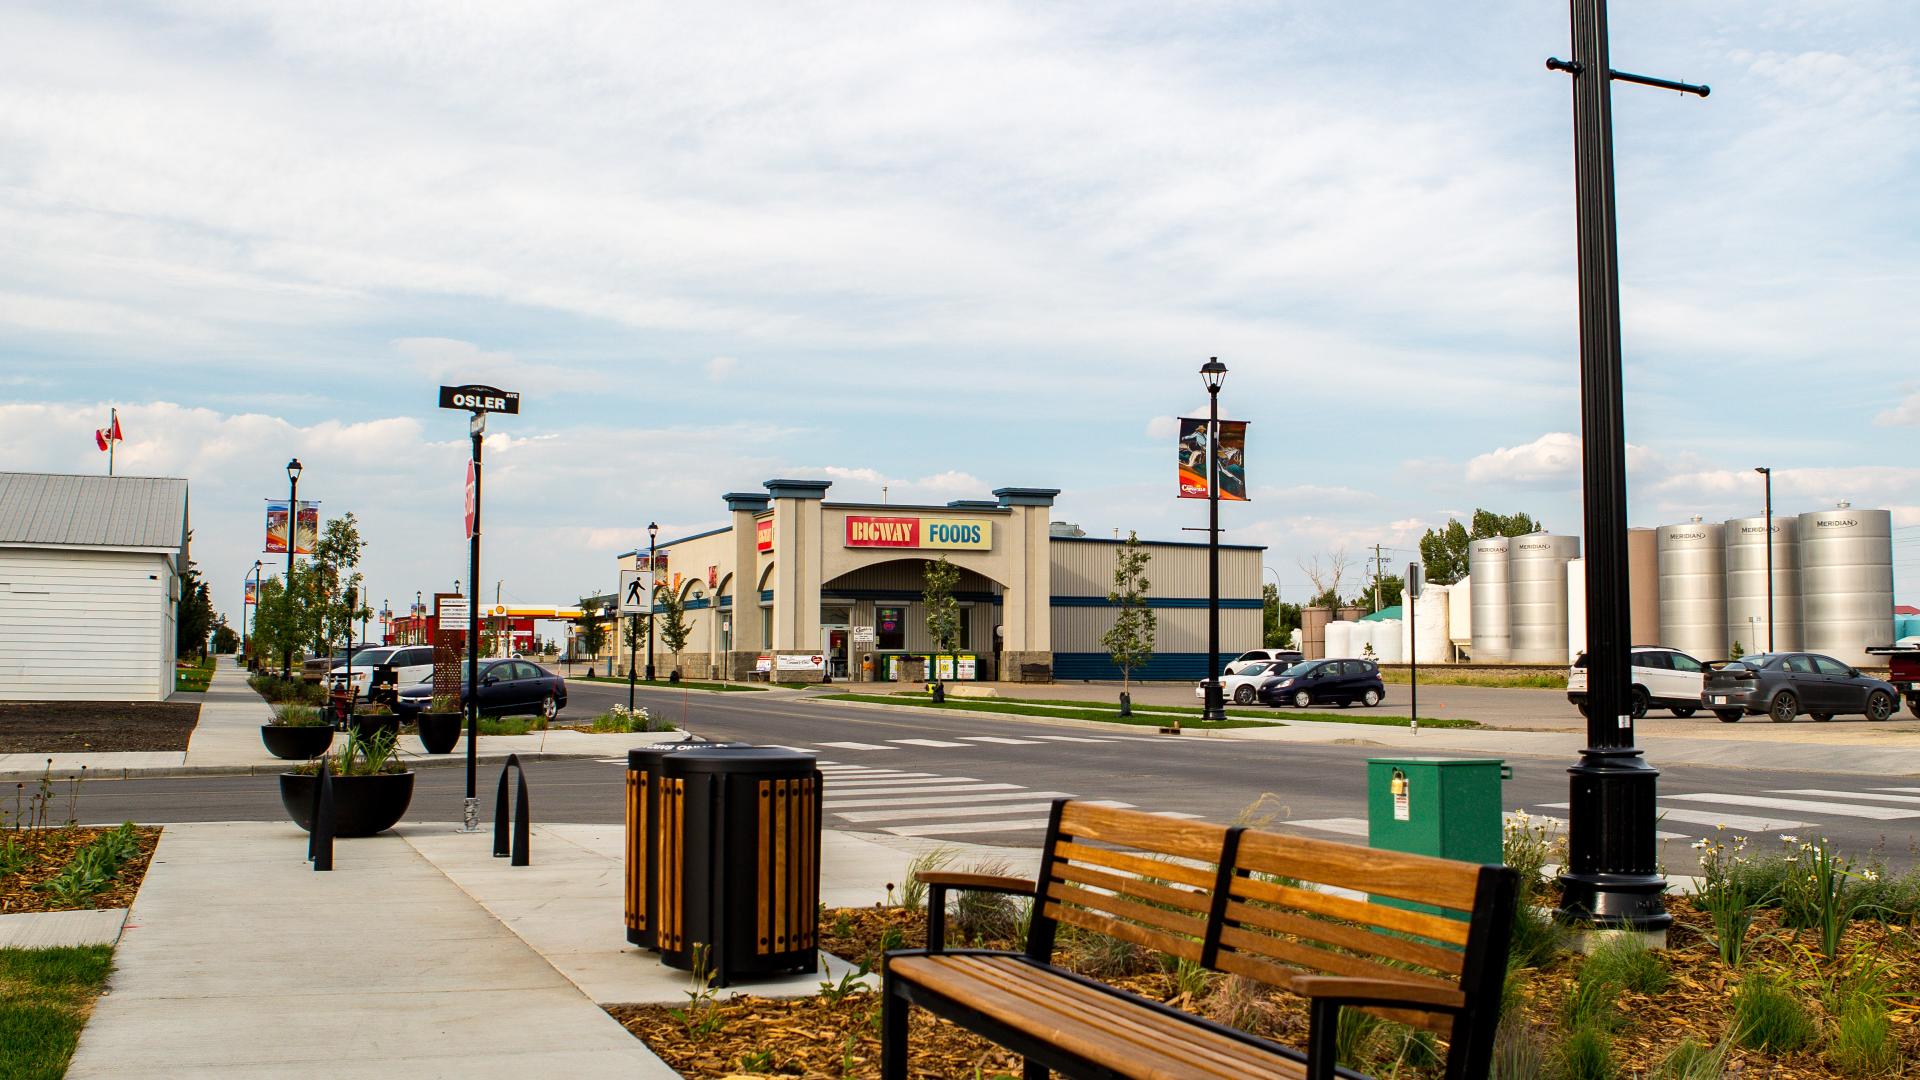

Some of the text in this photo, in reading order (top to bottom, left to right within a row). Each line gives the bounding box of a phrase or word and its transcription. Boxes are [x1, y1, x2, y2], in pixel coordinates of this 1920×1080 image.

[453, 394, 505, 410] OSLER
[853, 521, 981, 543] BIGWAY FOODS
[1741, 526, 1775, 534] MERIDIN
